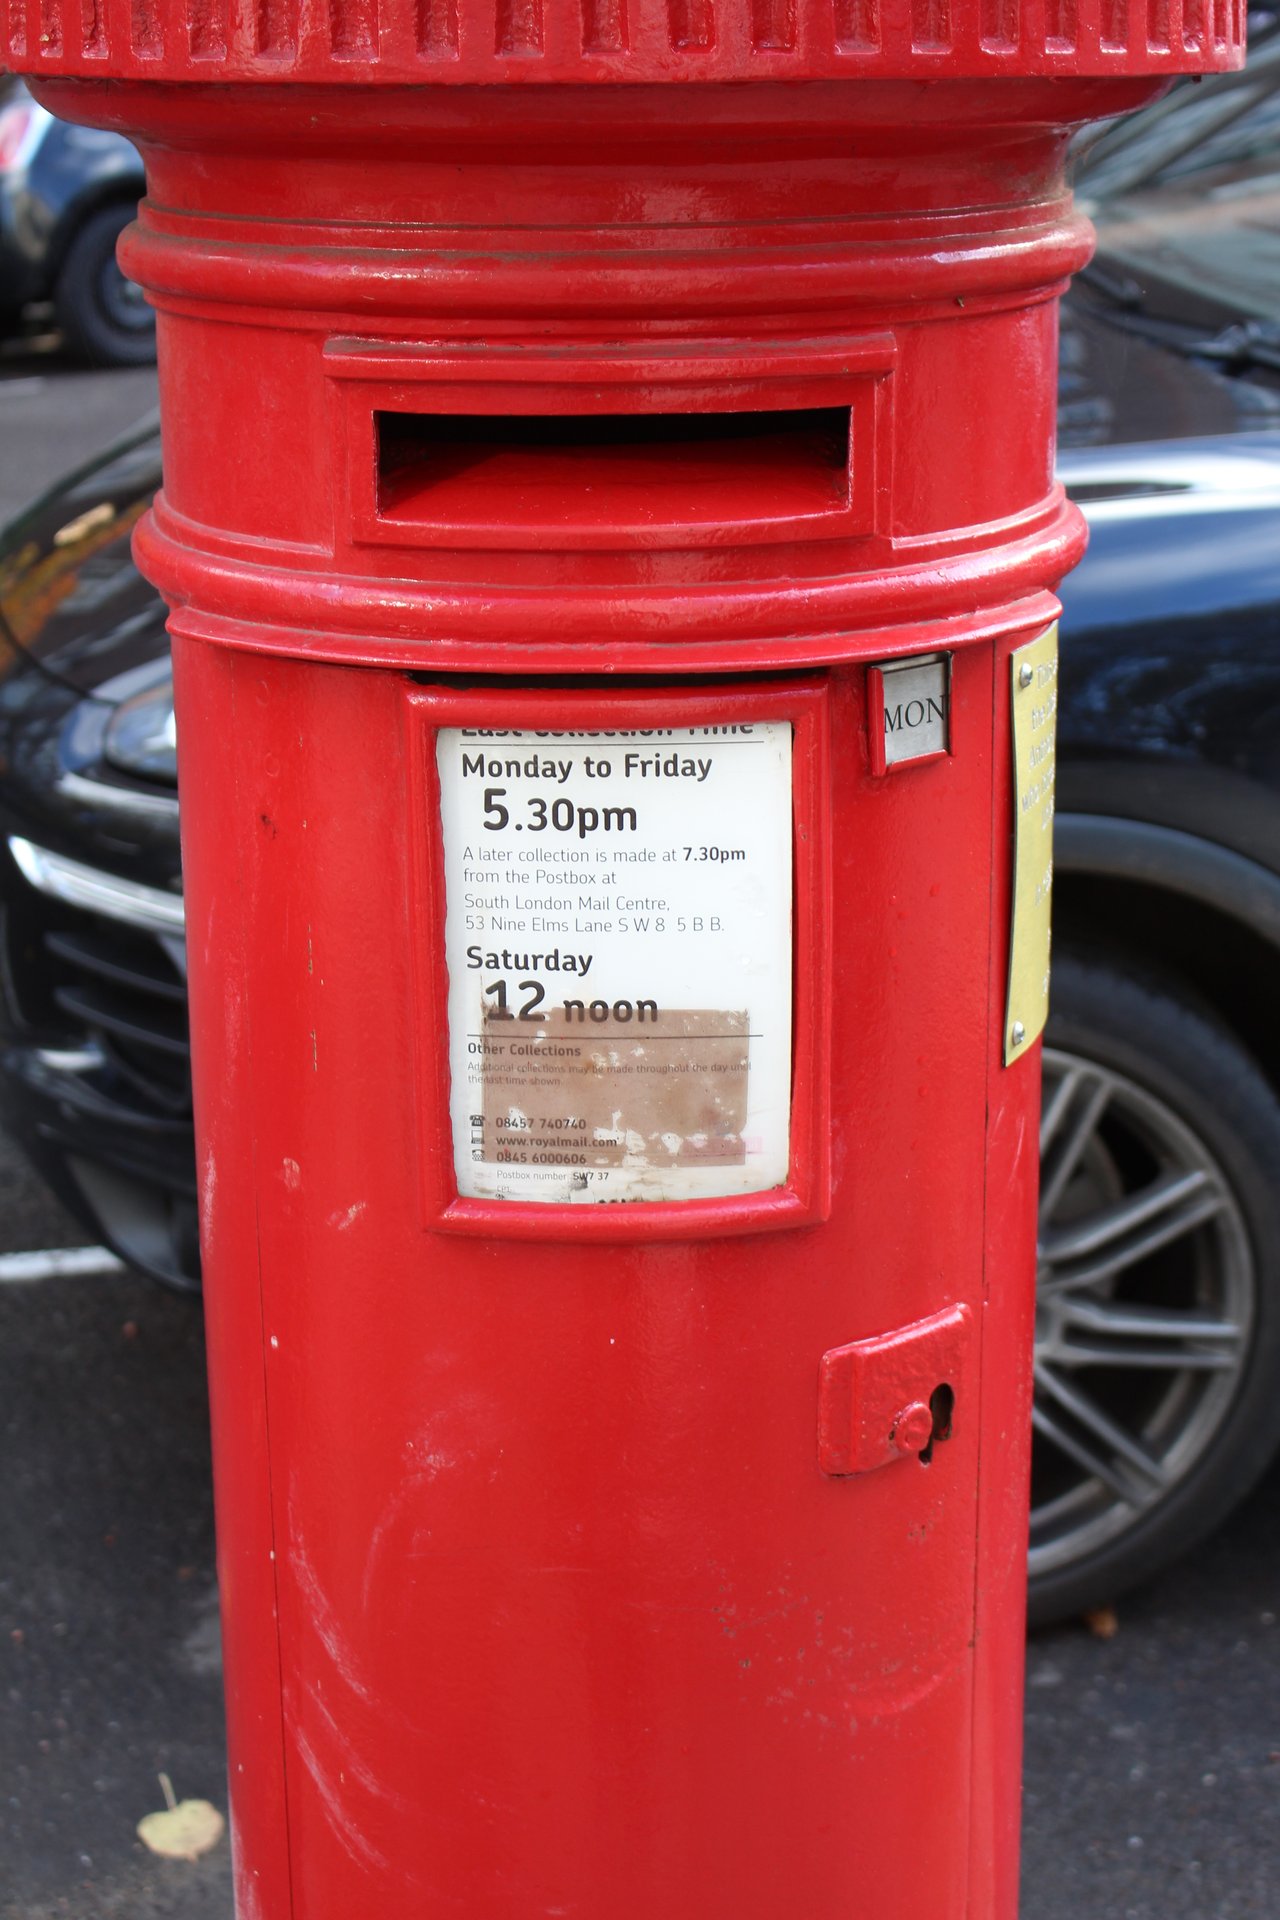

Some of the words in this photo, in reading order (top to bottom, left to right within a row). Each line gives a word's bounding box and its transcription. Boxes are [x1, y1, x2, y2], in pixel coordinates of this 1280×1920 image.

[884, 695, 946, 733] MON
[462, 753, 573, 783] Monday
[584, 756, 611, 778] to
[624, 753, 712, 782] Friday
[483, 788, 637, 839] 5.30pm
[463, 846, 474, 861] A
[478, 846, 513, 862] later
[518, 847, 589, 863] collection
[596, 847, 607, 862] is
[613, 847, 657, 863] made
[662, 848, 677, 862] at
[682, 846, 746, 863] 7.30pm
[463, 869, 500, 883] from
[505, 869, 530, 884] the
[536, 869, 596, 885] Postbox
[602, 871, 617, 885] at
[464, 894, 509, 909] South
[515, 895, 572, 910] London
[579, 896, 610, 911] Mail
[616, 896, 671, 912] Centre,
[465, 915, 485, 931] 53
[491, 916, 525, 932] Nine
[532, 917, 569, 932] Elms
[575, 918, 612, 932] Lane
[466, 945, 593, 977] Saturday
[485, 979, 546, 1022] 12
[563, 998, 658, 1023] noon
[468, 1042, 505, 1055] Other
[510, 1044, 581, 1056] Collections
[468, 1061, 513, 1072] Additional
[517, 1063, 567, 1073] collections
[569, 1065, 587, 1075] may
[636, 1063, 689, 1075] throughout
[693, 1063, 707, 1072] the
[711, 1063, 727, 1073] day
[468, 1075, 482, 1083] the
[506, 1075, 526, 1085] time
[496, 1117, 533, 1128] 08457
[540, 1118, 586, 1129] 740740
[496, 1136, 617, 1148] www.royalmail.com
[497, 1152, 527, 1163] 0845
[532, 1153, 586, 1164] 6000606
[497, 1170, 530, 1180] Postbox
[533, 1172, 566, 1181] number
[573, 1172, 594, 1181] SW7
[598, 1172, 609, 1180] 37
